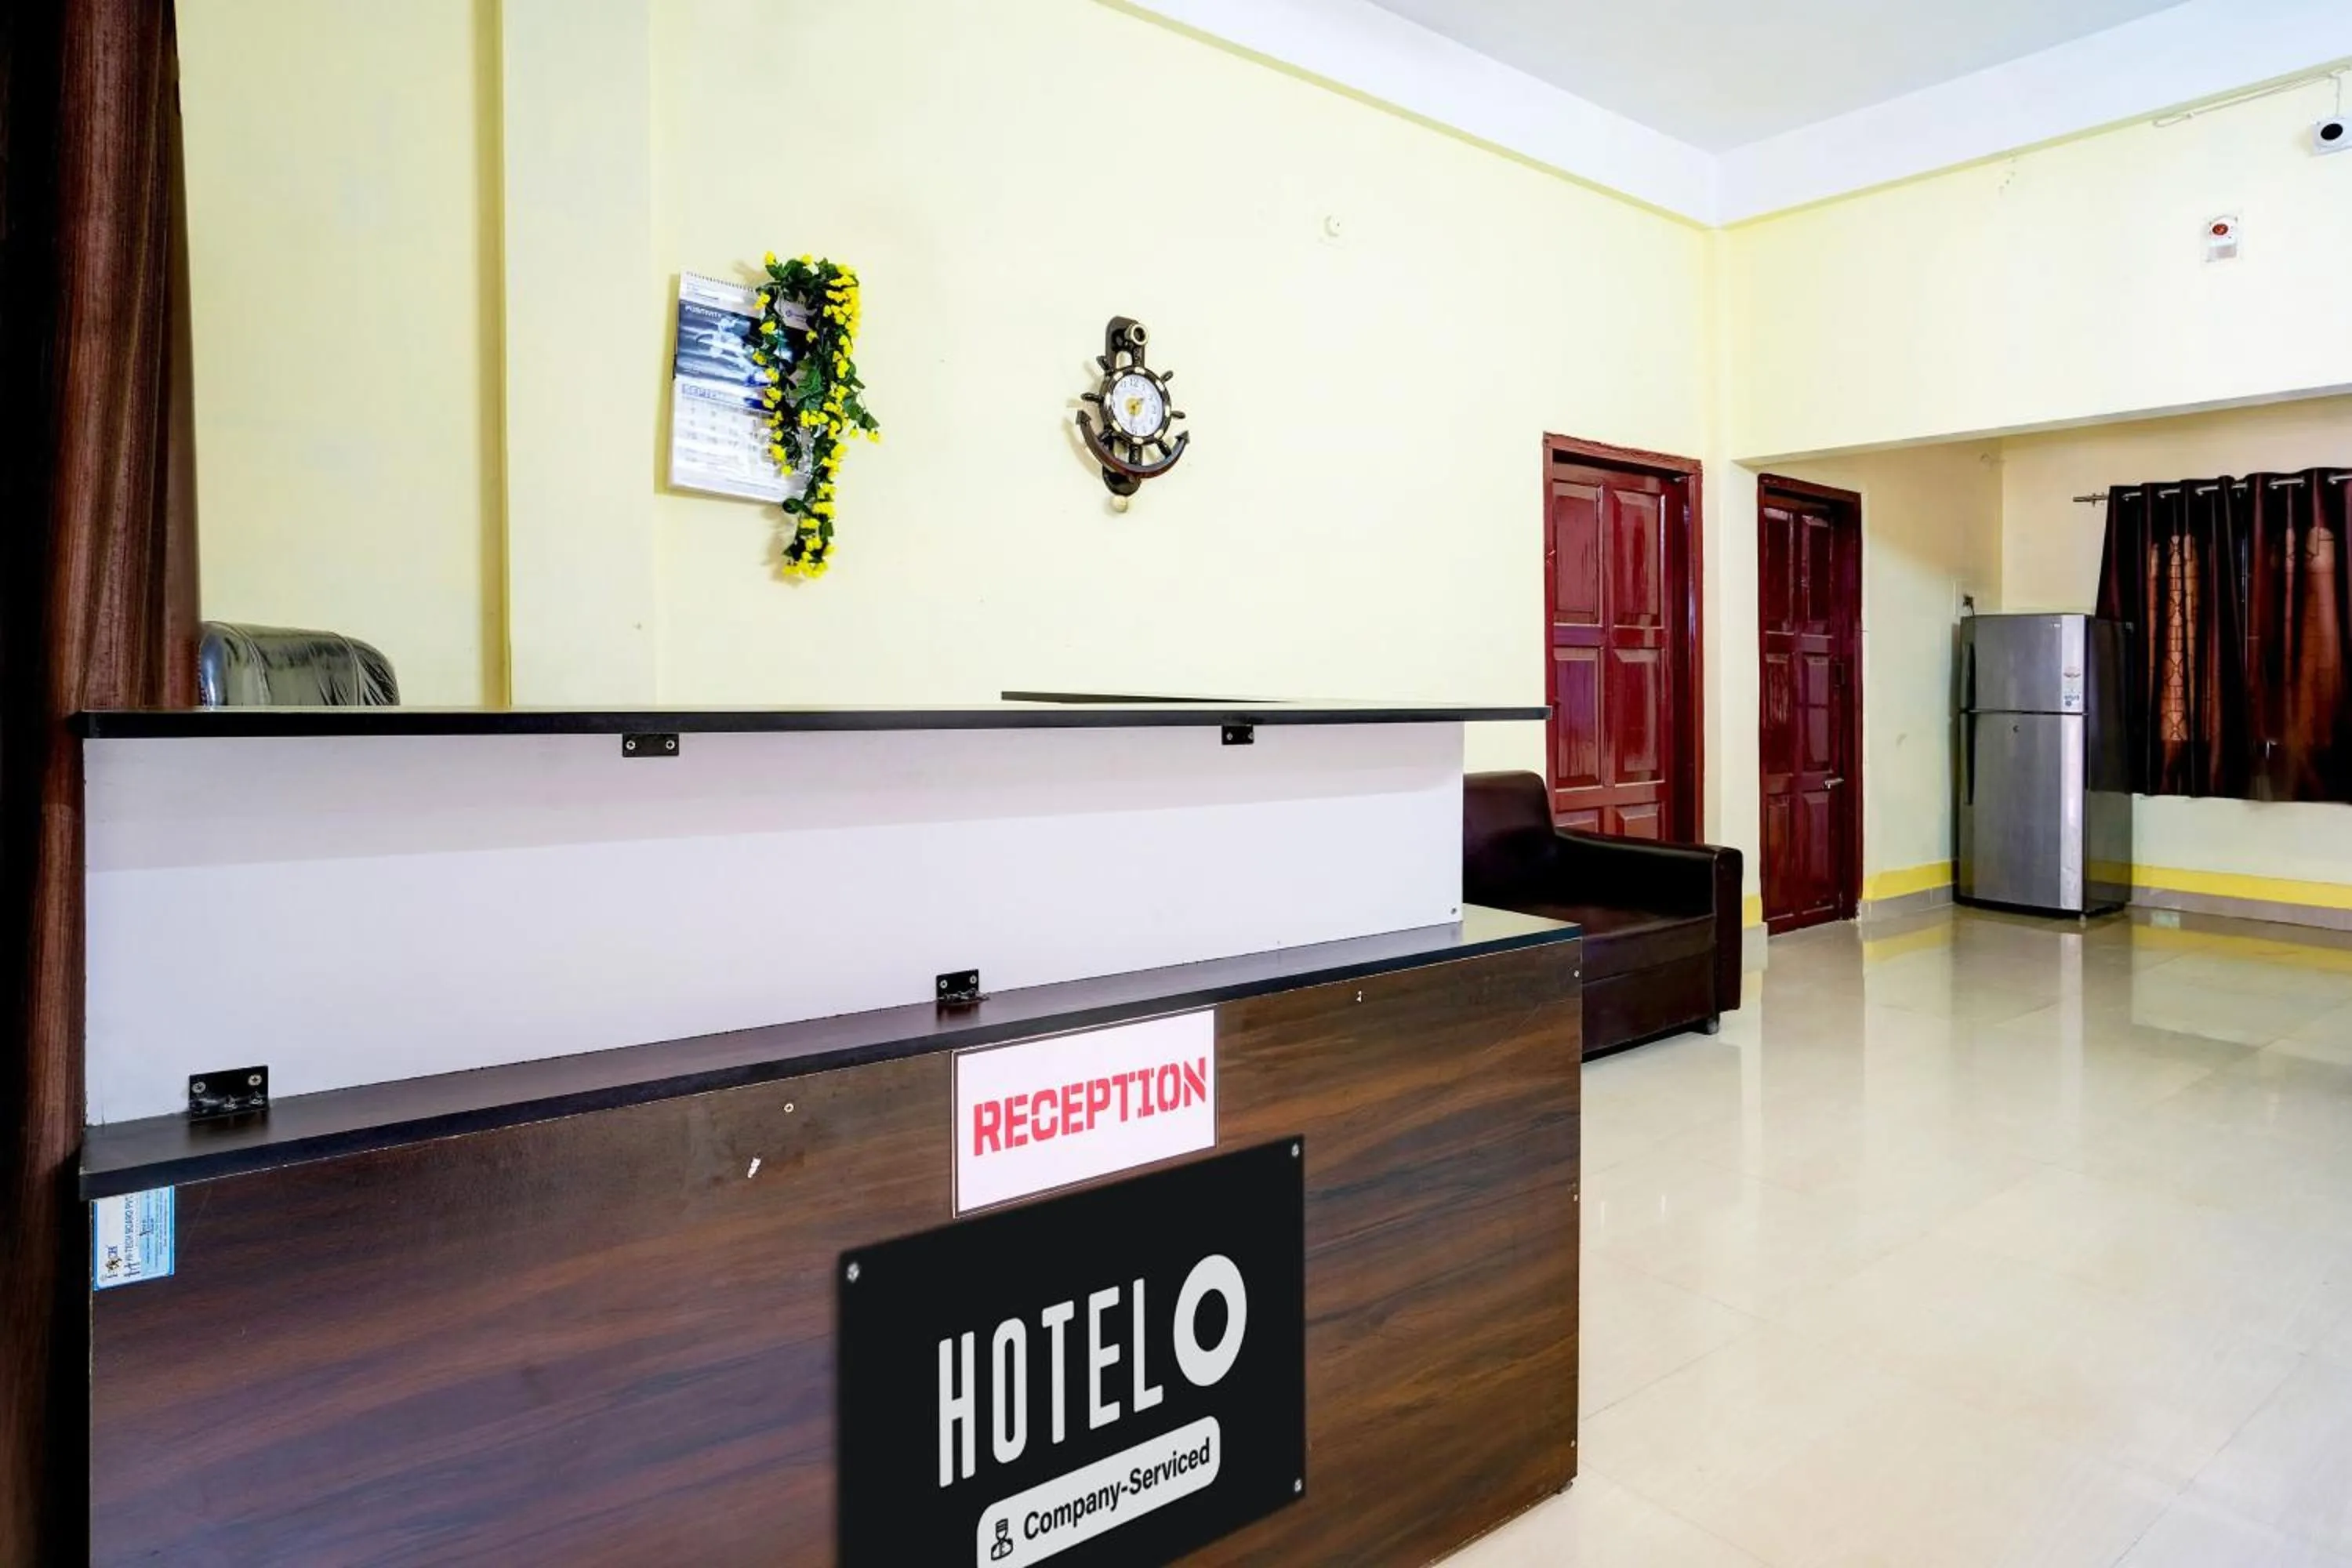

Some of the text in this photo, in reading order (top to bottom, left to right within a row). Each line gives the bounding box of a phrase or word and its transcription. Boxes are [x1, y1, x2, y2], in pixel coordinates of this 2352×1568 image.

[974, 1058, 1207, 1156] RECEPTION
[939, 1254, 1248, 1488] HOTEL O
[1024, 1437, 1210, 1541] Company-Serviced
